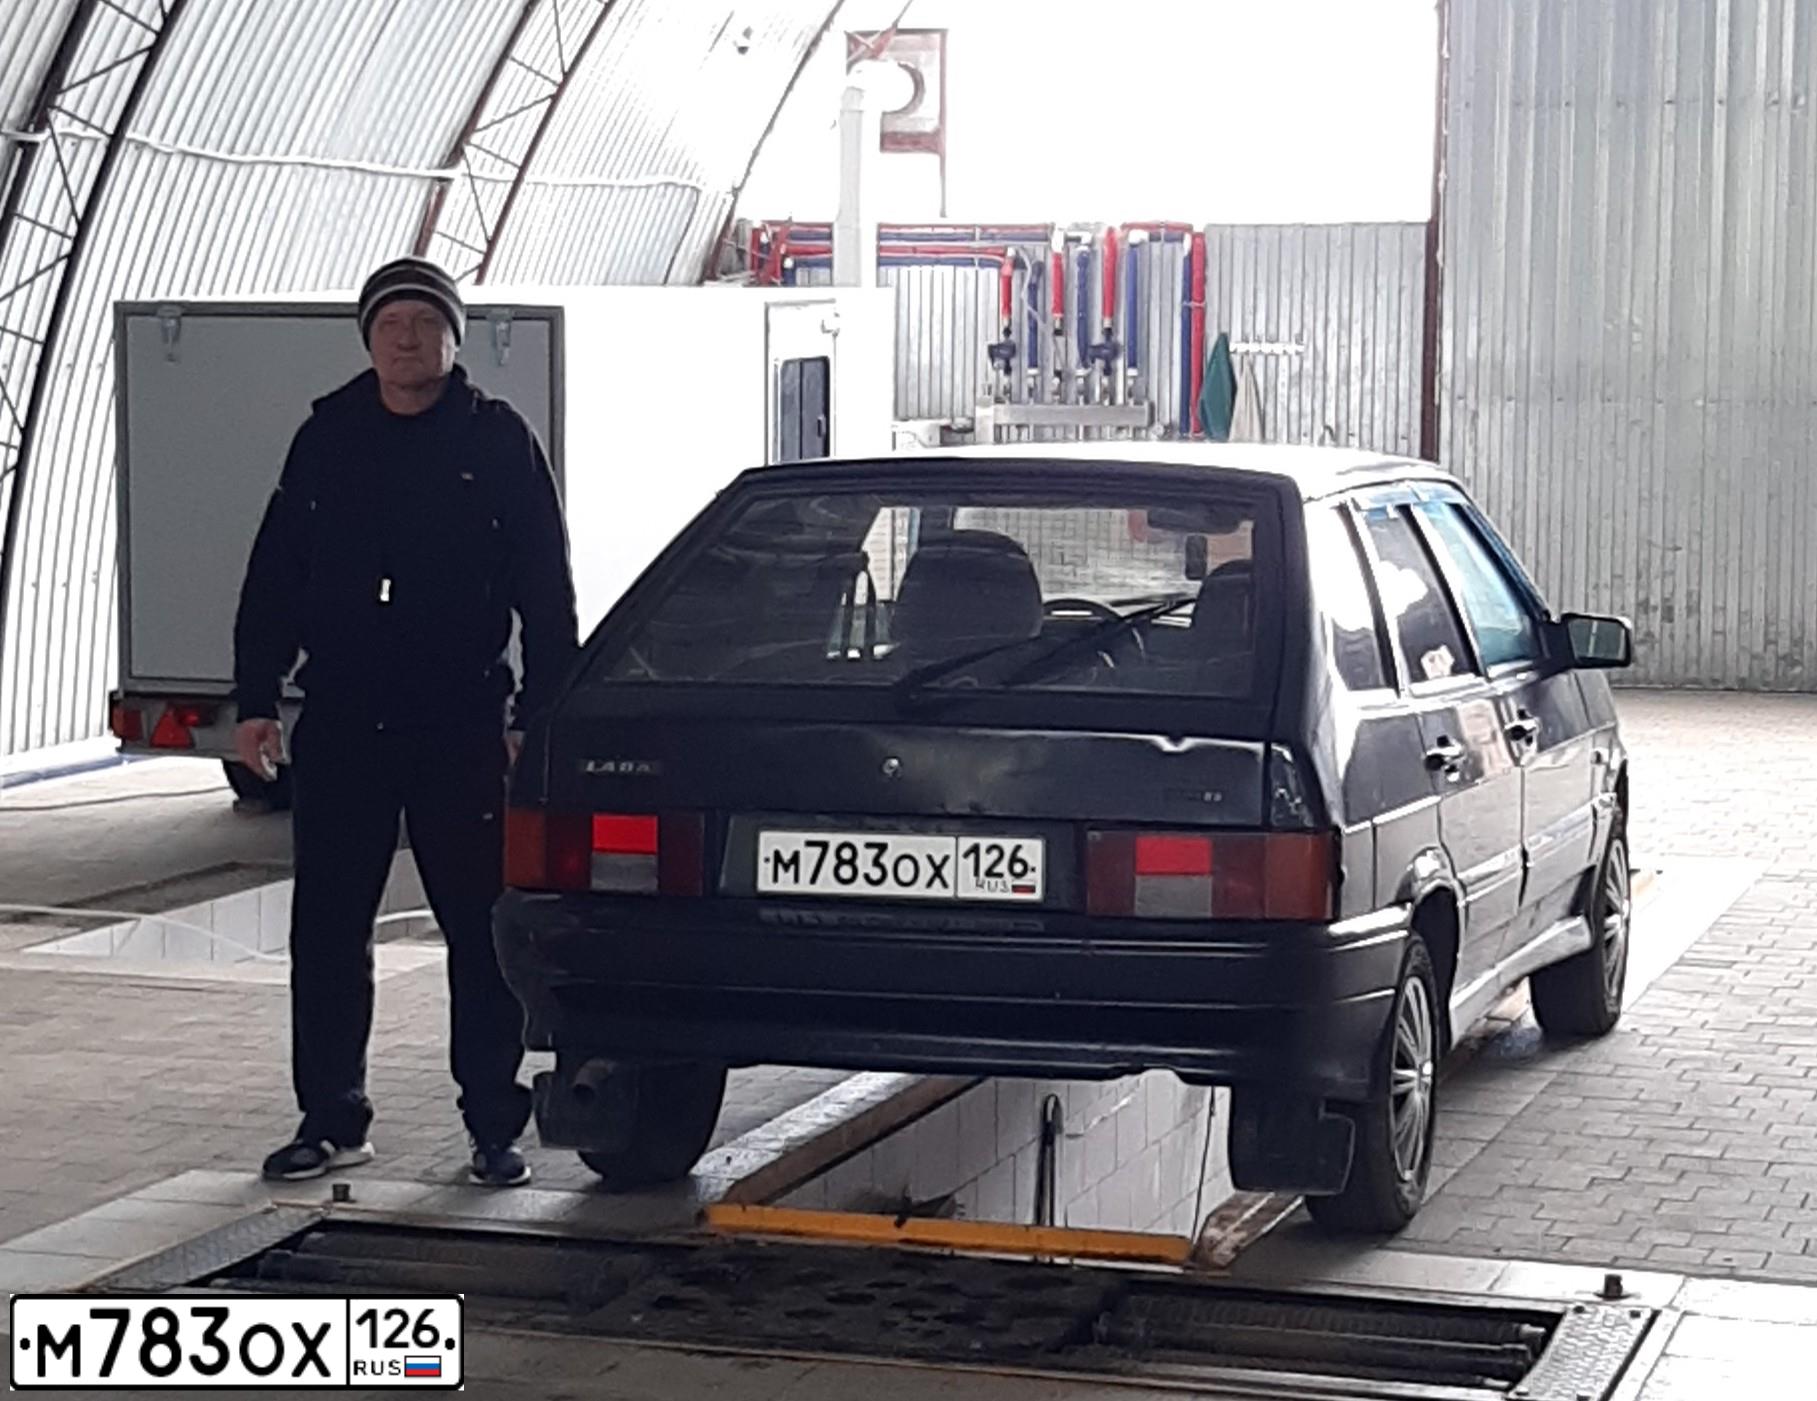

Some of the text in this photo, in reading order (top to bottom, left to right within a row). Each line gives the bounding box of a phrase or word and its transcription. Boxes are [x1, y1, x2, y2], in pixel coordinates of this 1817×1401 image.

[772, 840, 1029, 889] М783ОХ 126
[975, 878, 1010, 893] RUS
